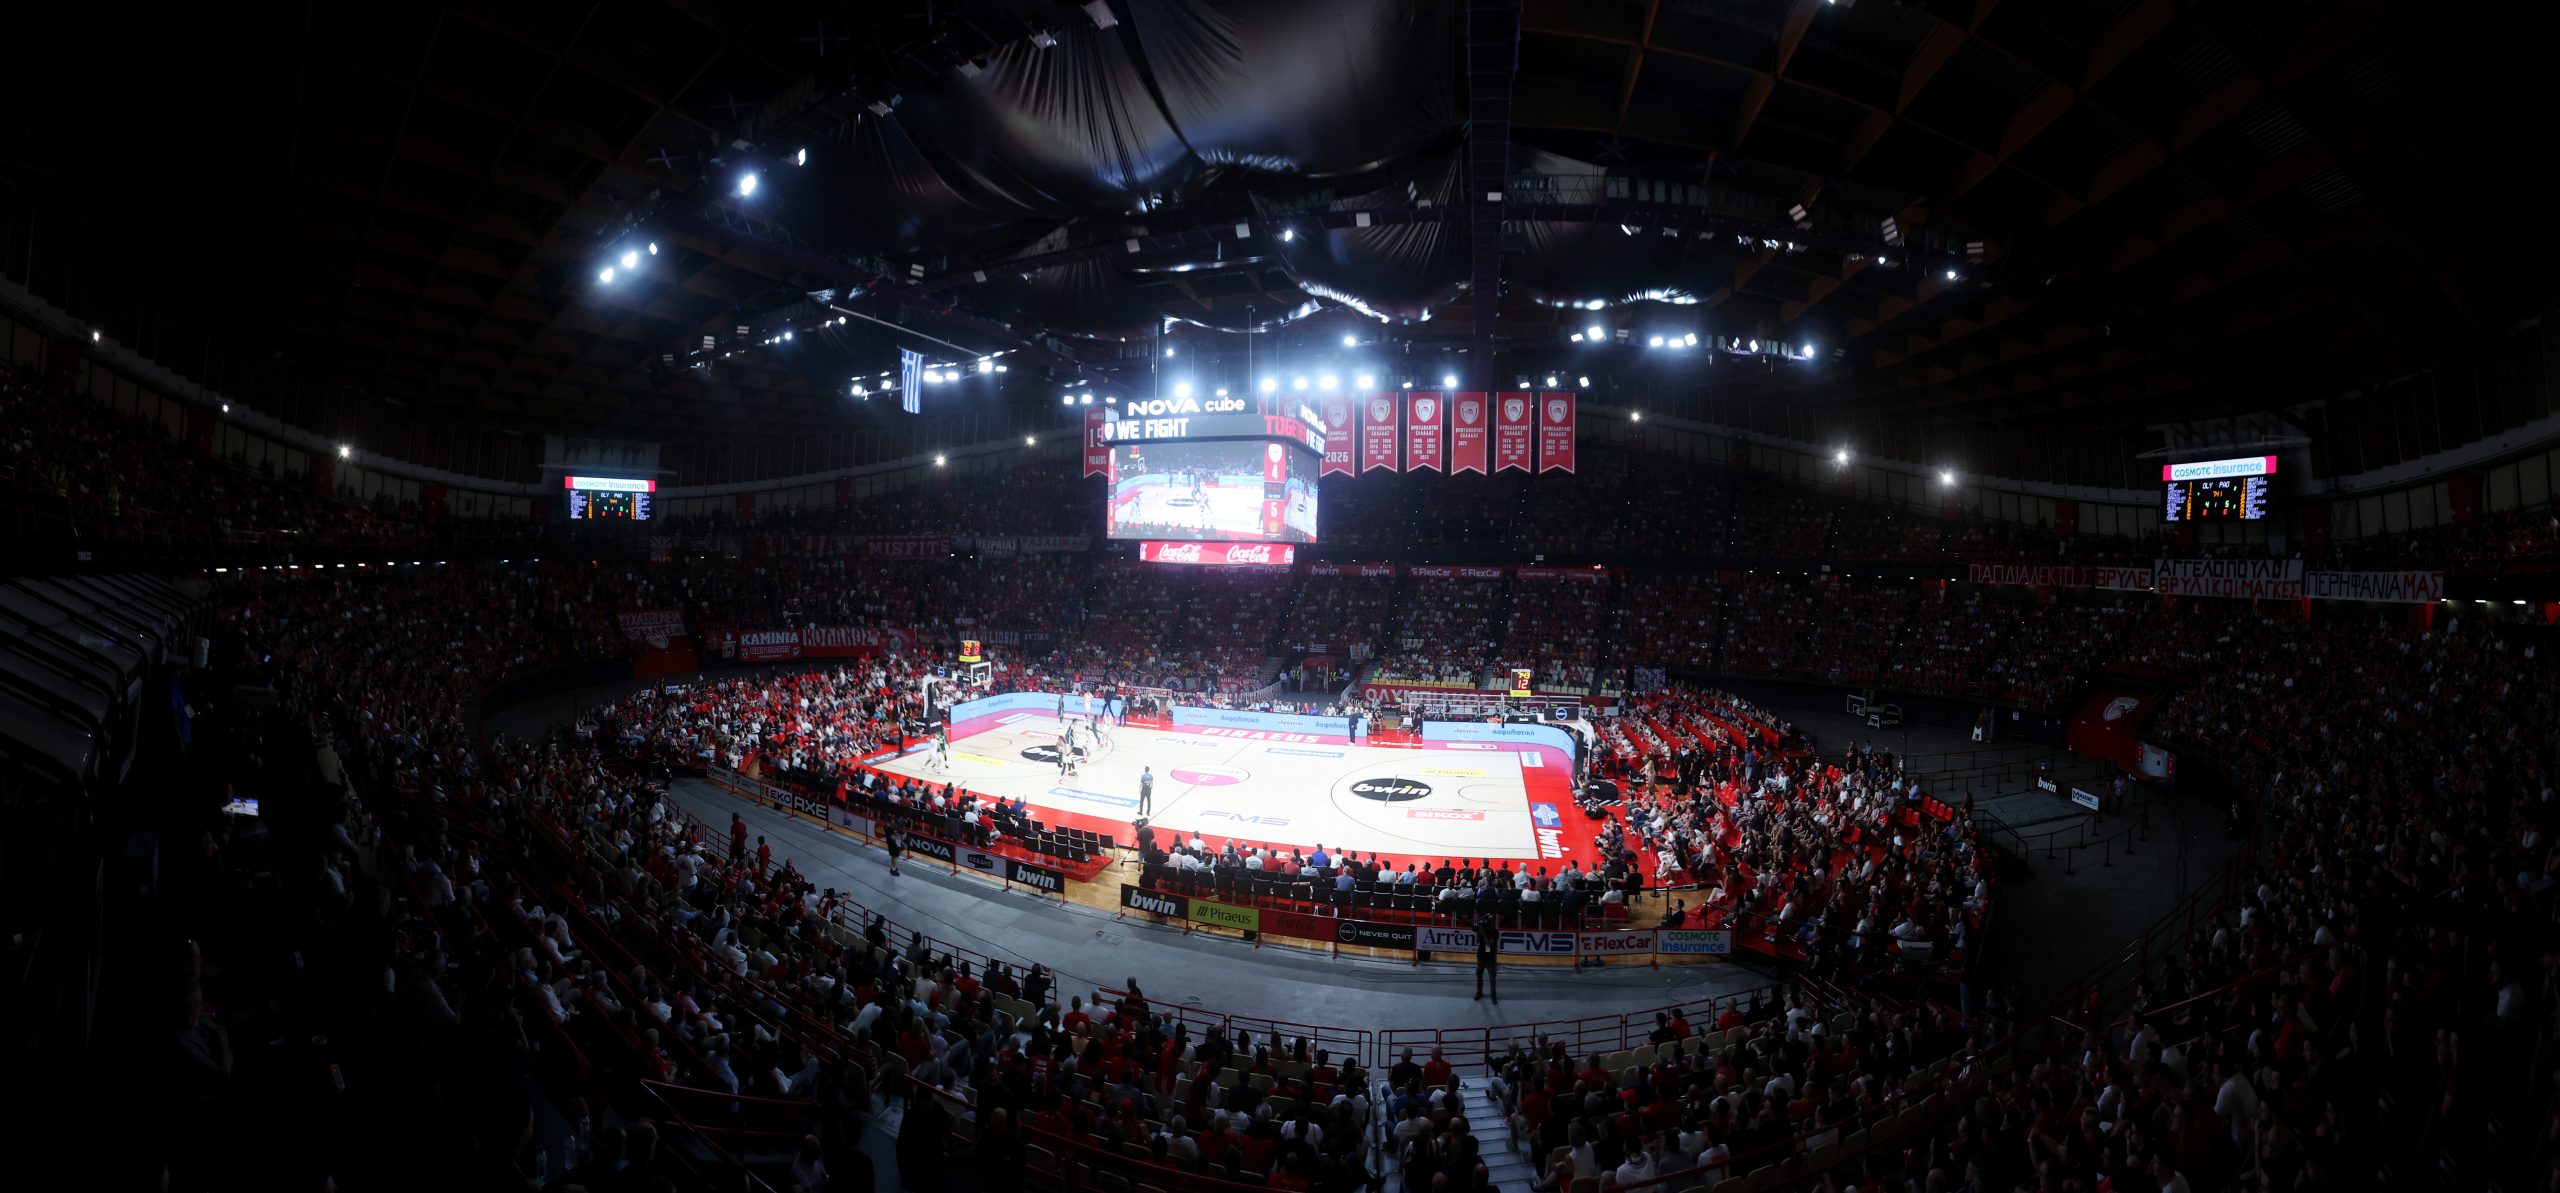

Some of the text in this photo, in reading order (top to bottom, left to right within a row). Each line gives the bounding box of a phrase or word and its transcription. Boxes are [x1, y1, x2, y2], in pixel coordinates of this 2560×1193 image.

[1128, 397, 1246, 416] NOVA cube
[1117, 419, 1140, 440] WE
[1325, 452, 1349, 463] 2026
[1271, 464, 1279, 480] 4
[1270, 501, 1278, 517] 5
[1311, 564, 1339, 576] bwin
[1362, 565, 1390, 576] bwin
[1418, 567, 1451, 577] FlexCar
[1467, 568, 1501, 578] FlexCar
[1518, 679, 1529, 689] 12
[1202, 727, 1321, 744] PIRAEUS
[1353, 783, 1430, 796] bwin
[2037, 776, 2057, 793] bwin
[770, 789, 792, 805] EKO
[794, 796, 827, 819] AXE
[1199, 810, 1291, 826] FMS
[909, 837, 951, 858] NOVA
[1016, 865, 1056, 889] bwin
[1129, 889, 1178, 915] bwin
[1210, 907, 1252, 925] Piraeus
[1359, 929, 1390, 939] NEVER
[1392, 932, 1413, 941] QUIT
[1499, 932, 1574, 952] FMS
[1595, 936, 1651, 950] FlexCar
[1668, 932, 1720, 942] COSMOTE
